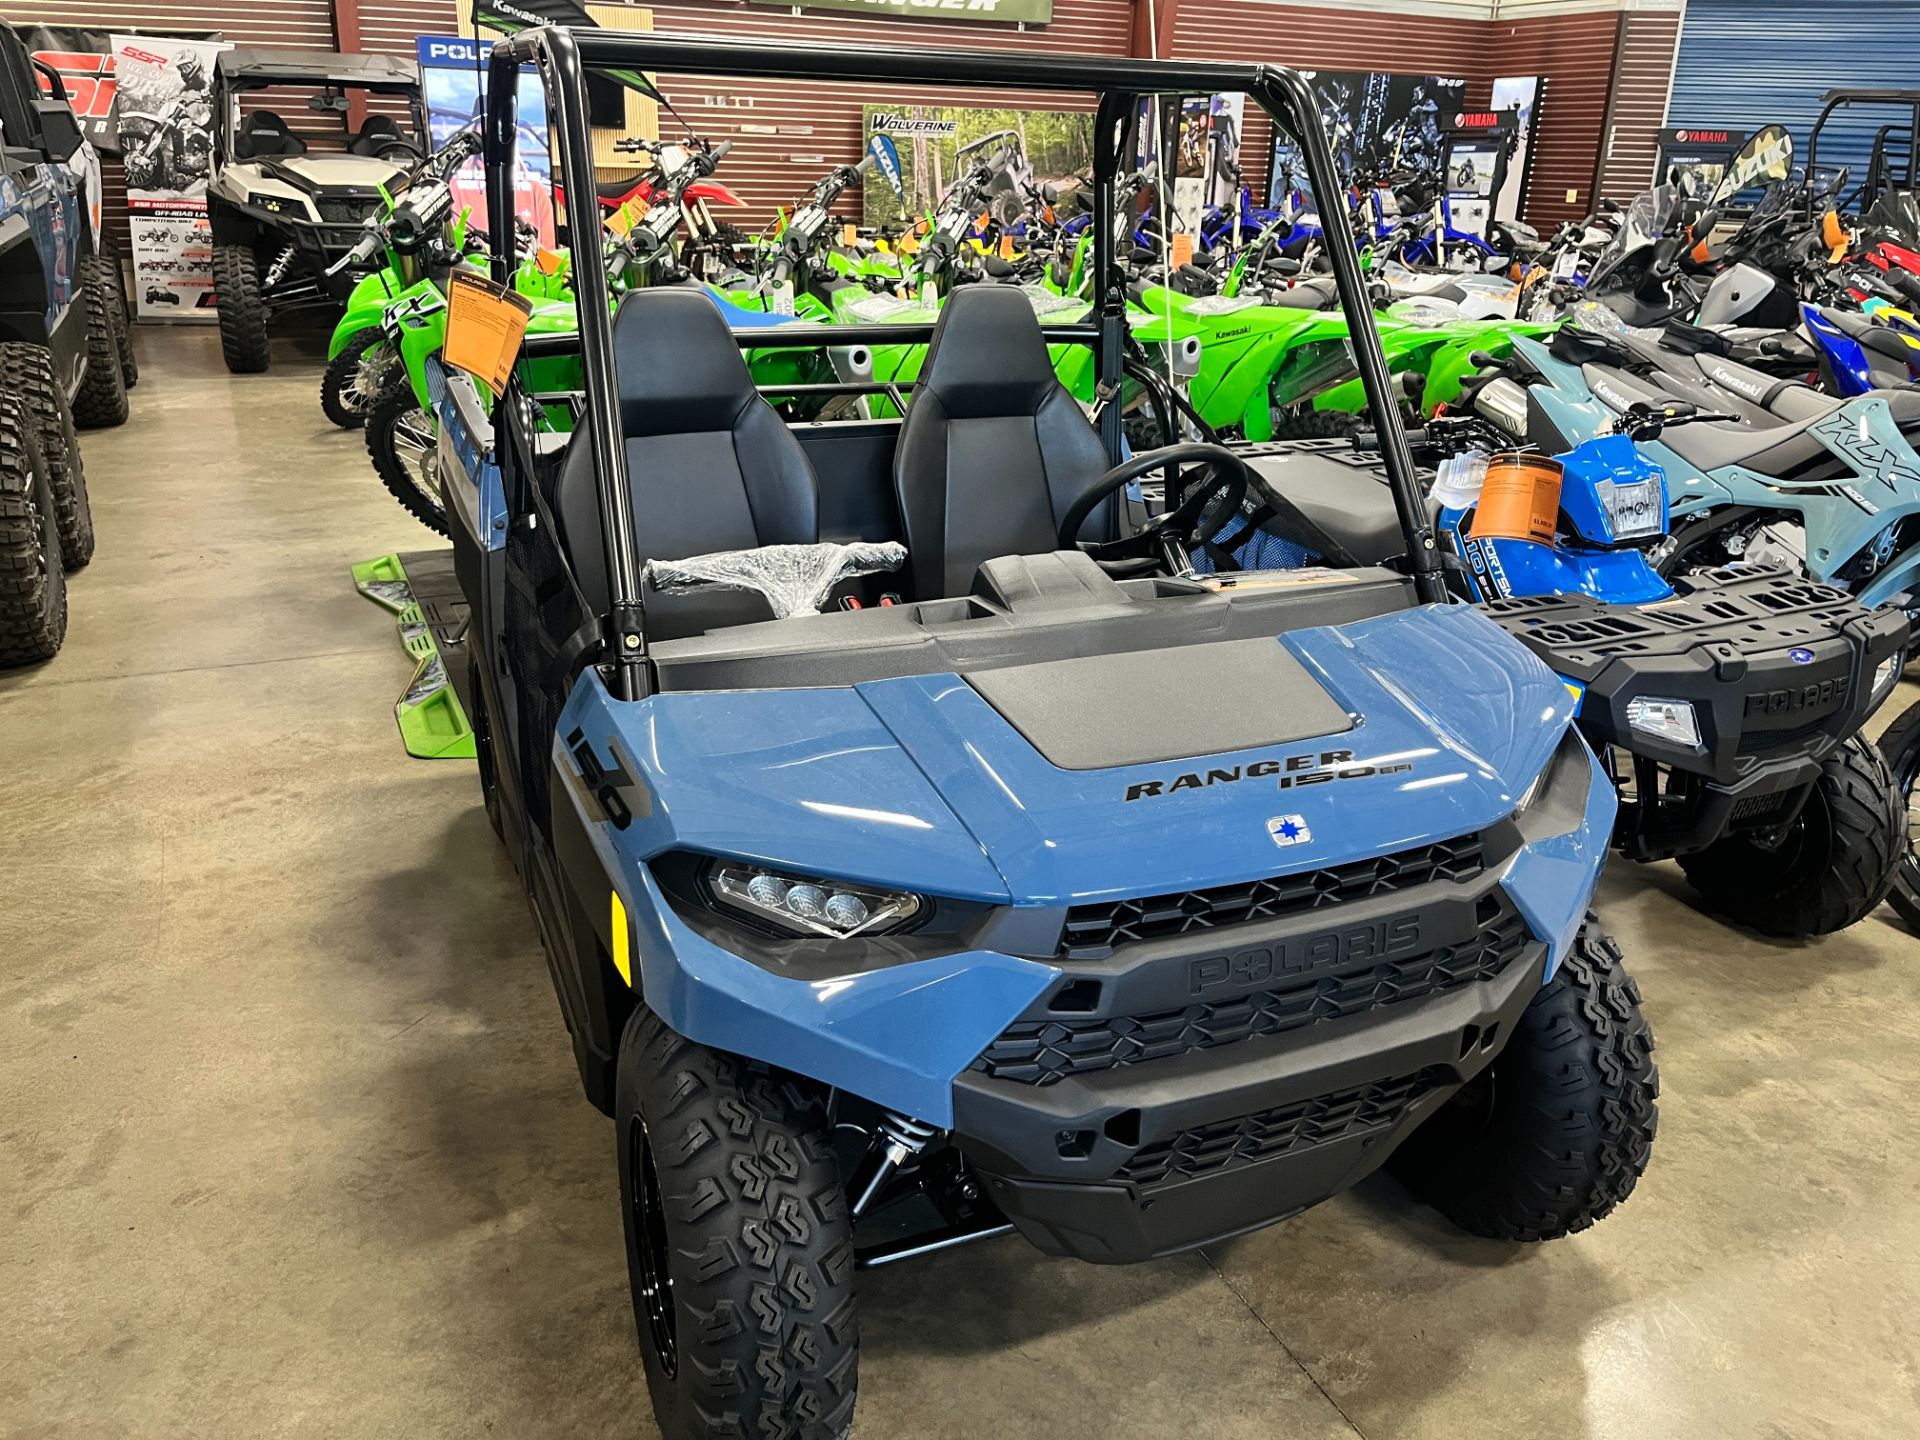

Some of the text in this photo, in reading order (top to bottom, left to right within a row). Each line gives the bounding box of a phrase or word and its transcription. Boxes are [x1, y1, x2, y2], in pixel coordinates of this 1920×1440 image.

[120, 46, 168, 70] SSR
[872, 113, 956, 131] WOLVERINE
[1465, 113, 1498, 127] YAMAHA
[1688, 131, 1727, 142] YAMAHA
[871, 135, 902, 194] SUZUKI
[1716, 134, 1792, 203] SUZUKI
[384, 292, 431, 327] KX
[1215, 325, 1251, 340] Kawasaki
[1713, 366, 1762, 397] Kawasaki
[1815, 412, 1920, 494] KLX
[1743, 675, 1850, 718] POLARIS
[1126, 750, 1354, 801] RANGER
[1280, 764, 1412, 790] 150 EFI
[1190, 914, 1419, 996] POLARIS
